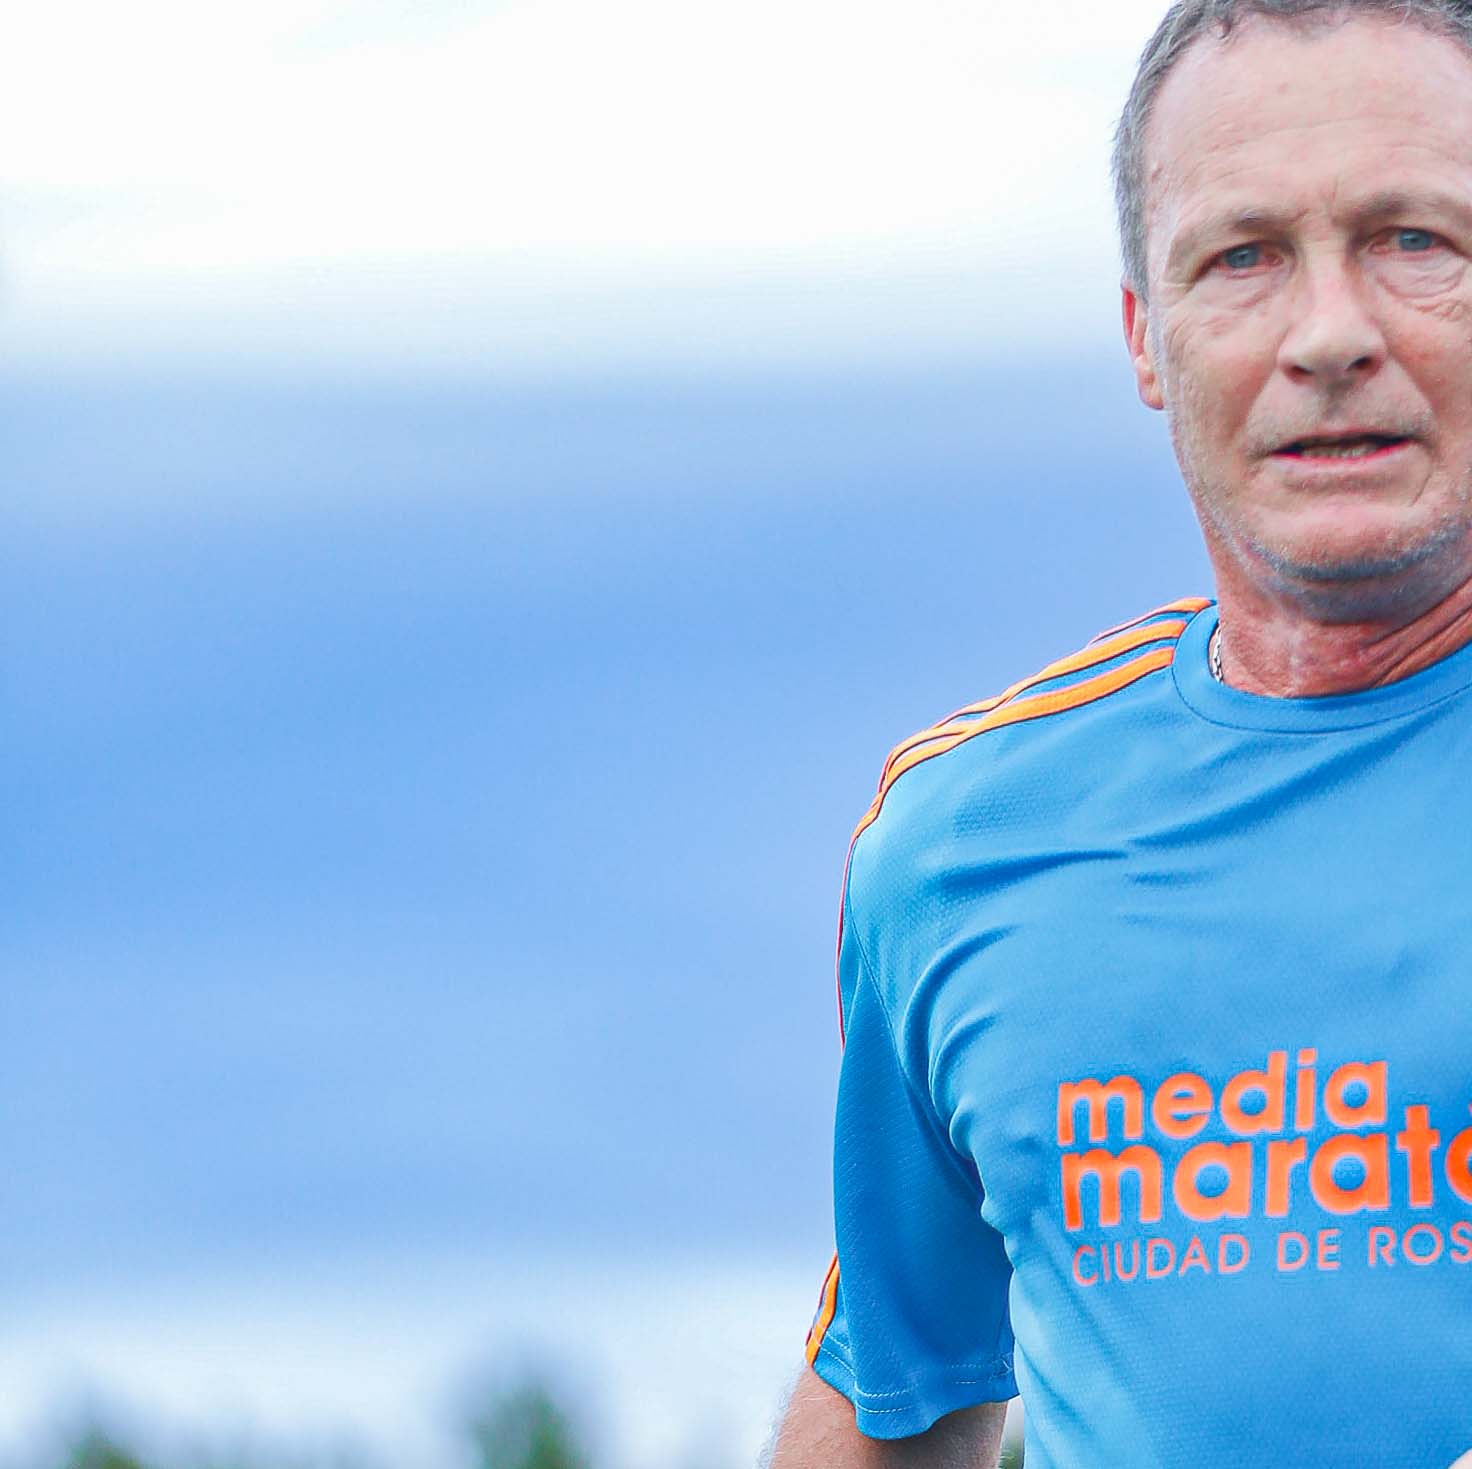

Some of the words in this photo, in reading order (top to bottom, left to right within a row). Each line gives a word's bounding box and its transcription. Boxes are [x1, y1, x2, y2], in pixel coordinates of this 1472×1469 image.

[1057, 1047, 1387, 1145] media
[1073, 1232, 1250, 1286] CIUDAD
[1277, 1228, 1341, 1272] DE
